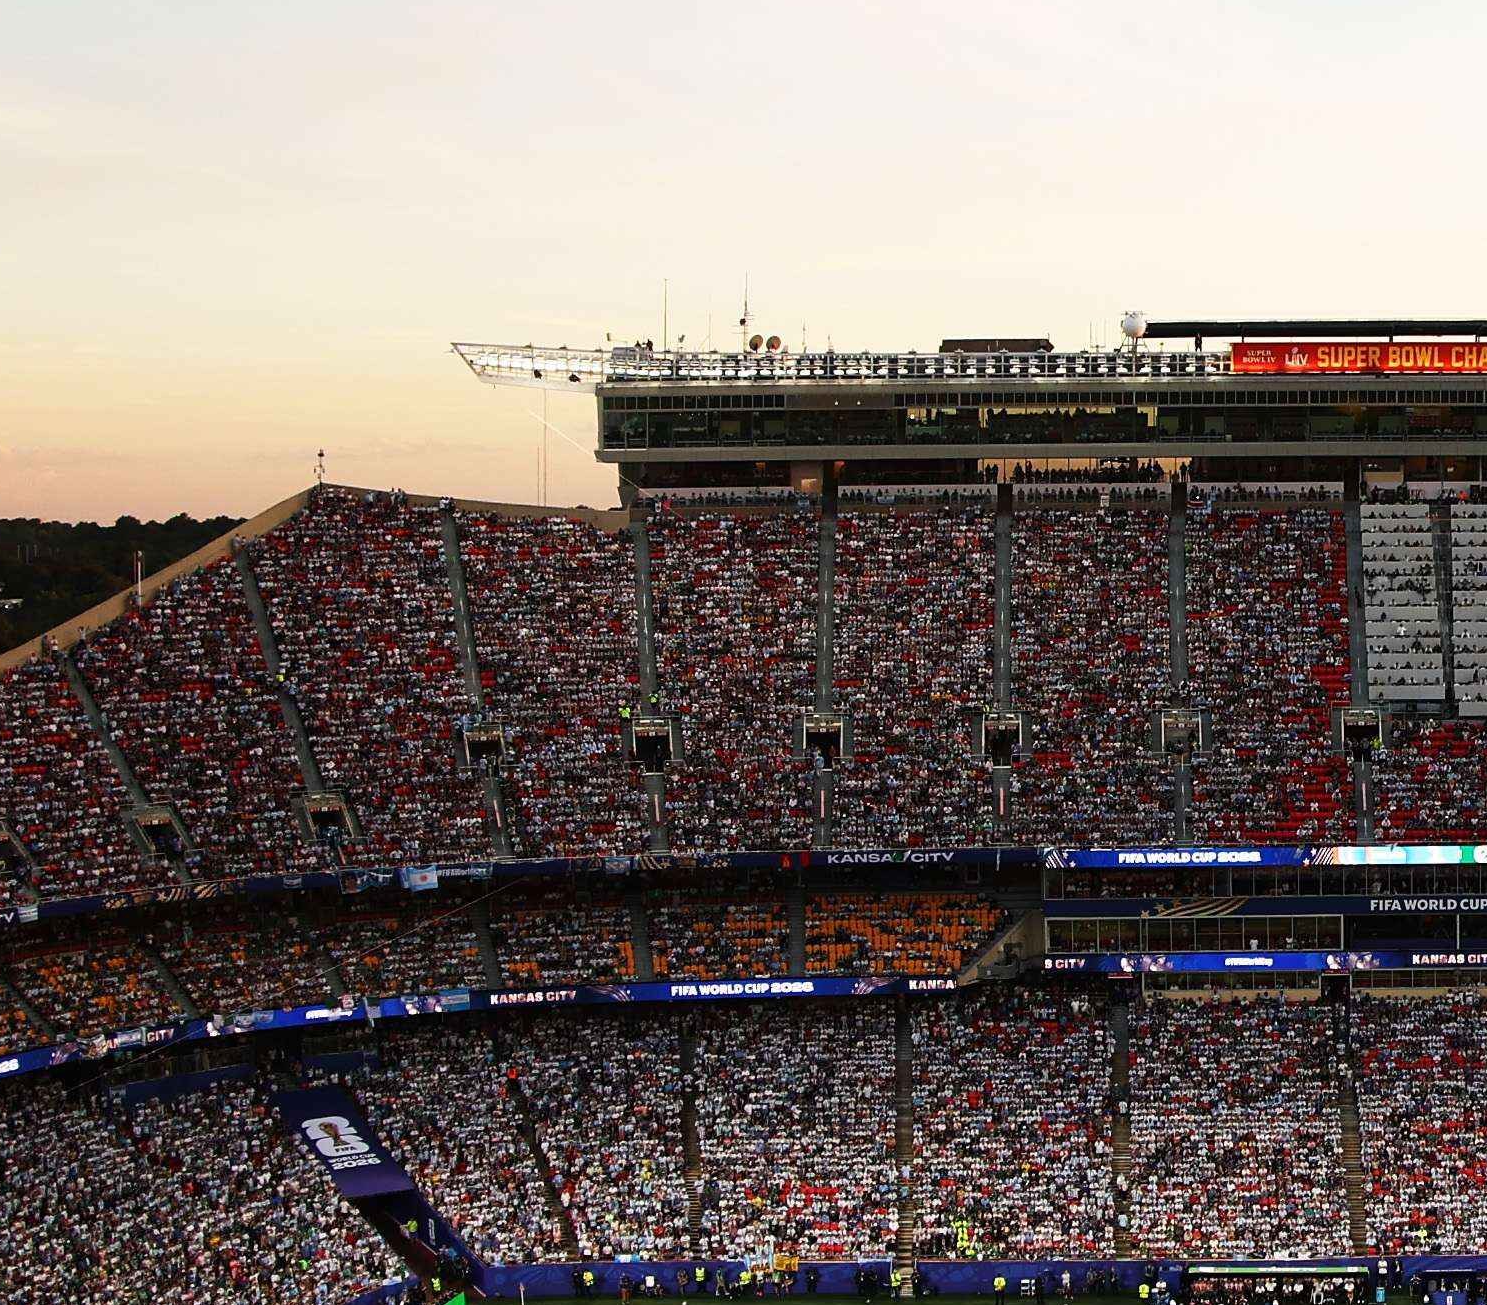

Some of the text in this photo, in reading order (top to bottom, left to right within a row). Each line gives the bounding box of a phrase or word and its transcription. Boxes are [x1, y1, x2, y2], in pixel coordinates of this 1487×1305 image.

[1317, 347, 1380, 368] SUPER
[1388, 346, 1444, 368] BOWL
[827, 852, 954, 864] KANSA CITY
[1118, 853, 1145, 865] FIFA
[1146, 852, 1191, 864] WORLD
[1193, 852, 1216, 863] CUP
[1370, 899, 1401, 911] FIFA
[1403, 899, 1457, 911] WORLD
[1056, 958, 1086, 969] CITY
[1412, 954, 1465, 964] KANSAS
[671, 985, 697, 997] FIFA
[699, 984, 743, 996] WORLD
[745, 983, 770, 994] CUP
[490, 990, 576, 1005] KANSAS CITY
[332, 1158, 381, 1170] 2026
